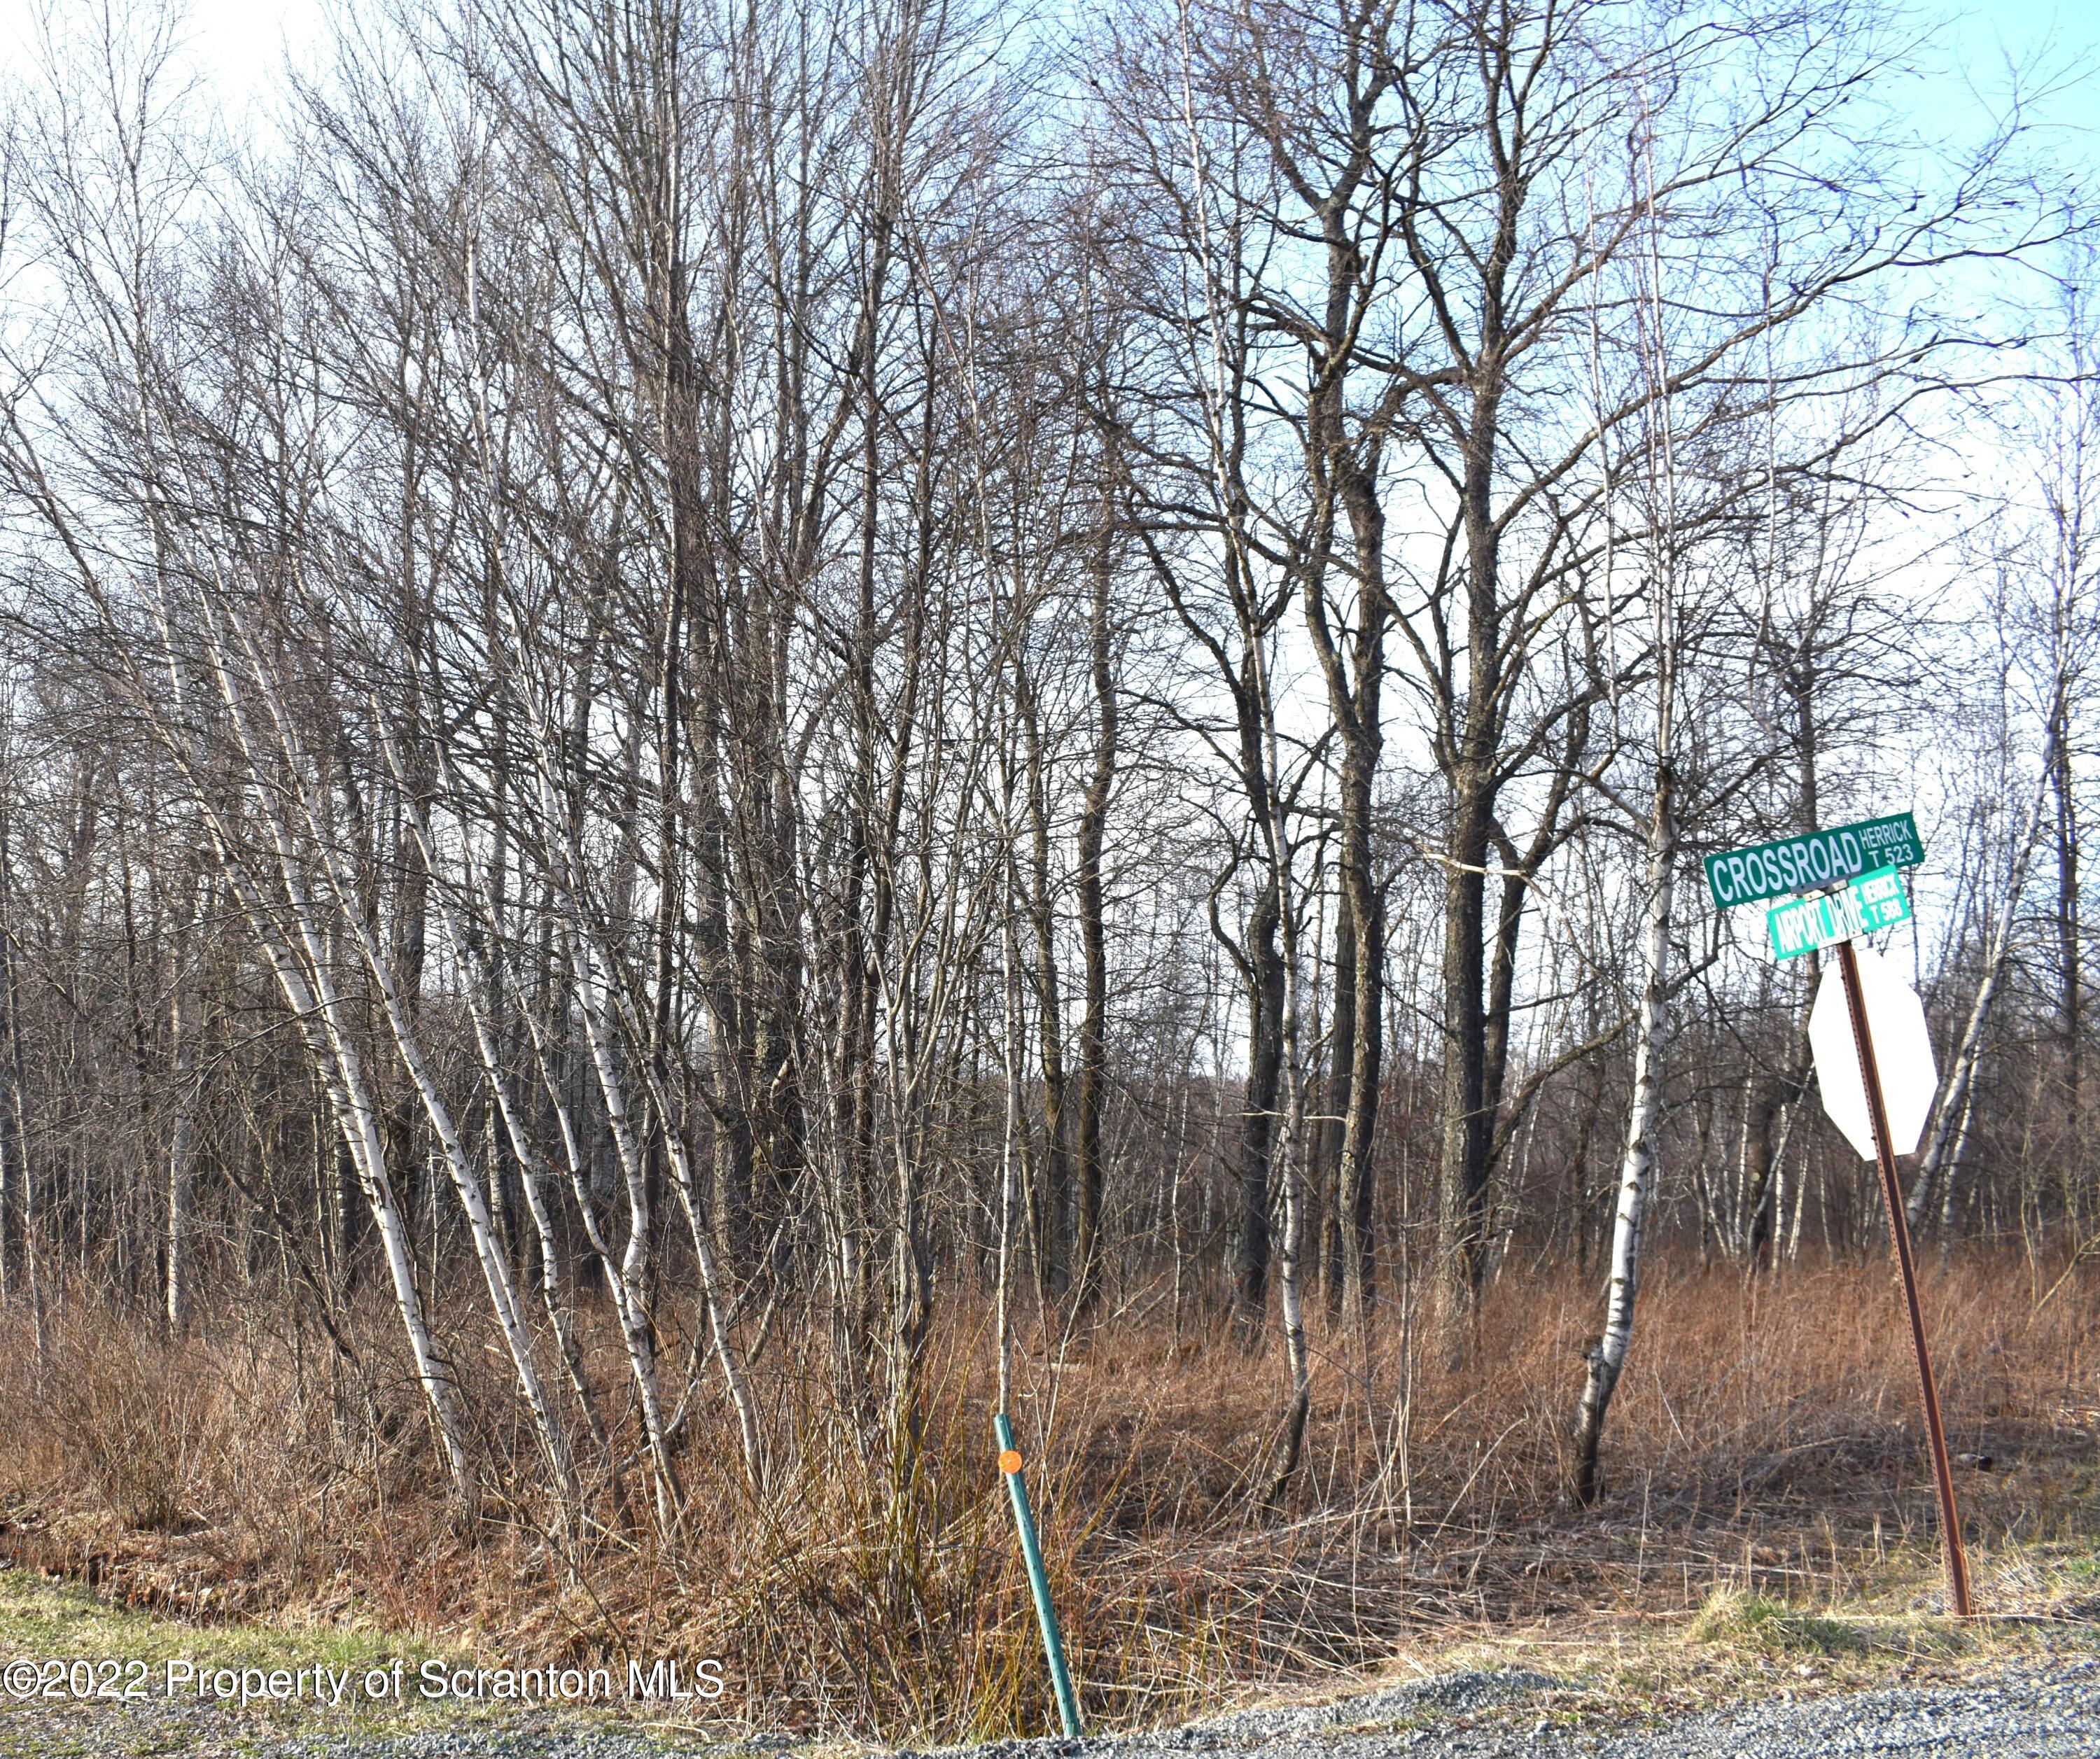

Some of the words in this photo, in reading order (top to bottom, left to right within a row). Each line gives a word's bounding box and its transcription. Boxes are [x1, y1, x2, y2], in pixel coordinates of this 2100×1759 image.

[1858, 820, 1912, 850] HERRICK
[1714, 832, 1863, 902] CROSSROAD
[1868, 850, 1879, 868] T
[1885, 844, 1914, 865] 523
[1861, 873, 1898, 905] HERRICK
[1774, 898, 1826, 953] AIRPORT
[1824, 885, 1868, 938] DRIVE
[1869, 906, 1879, 925] T
